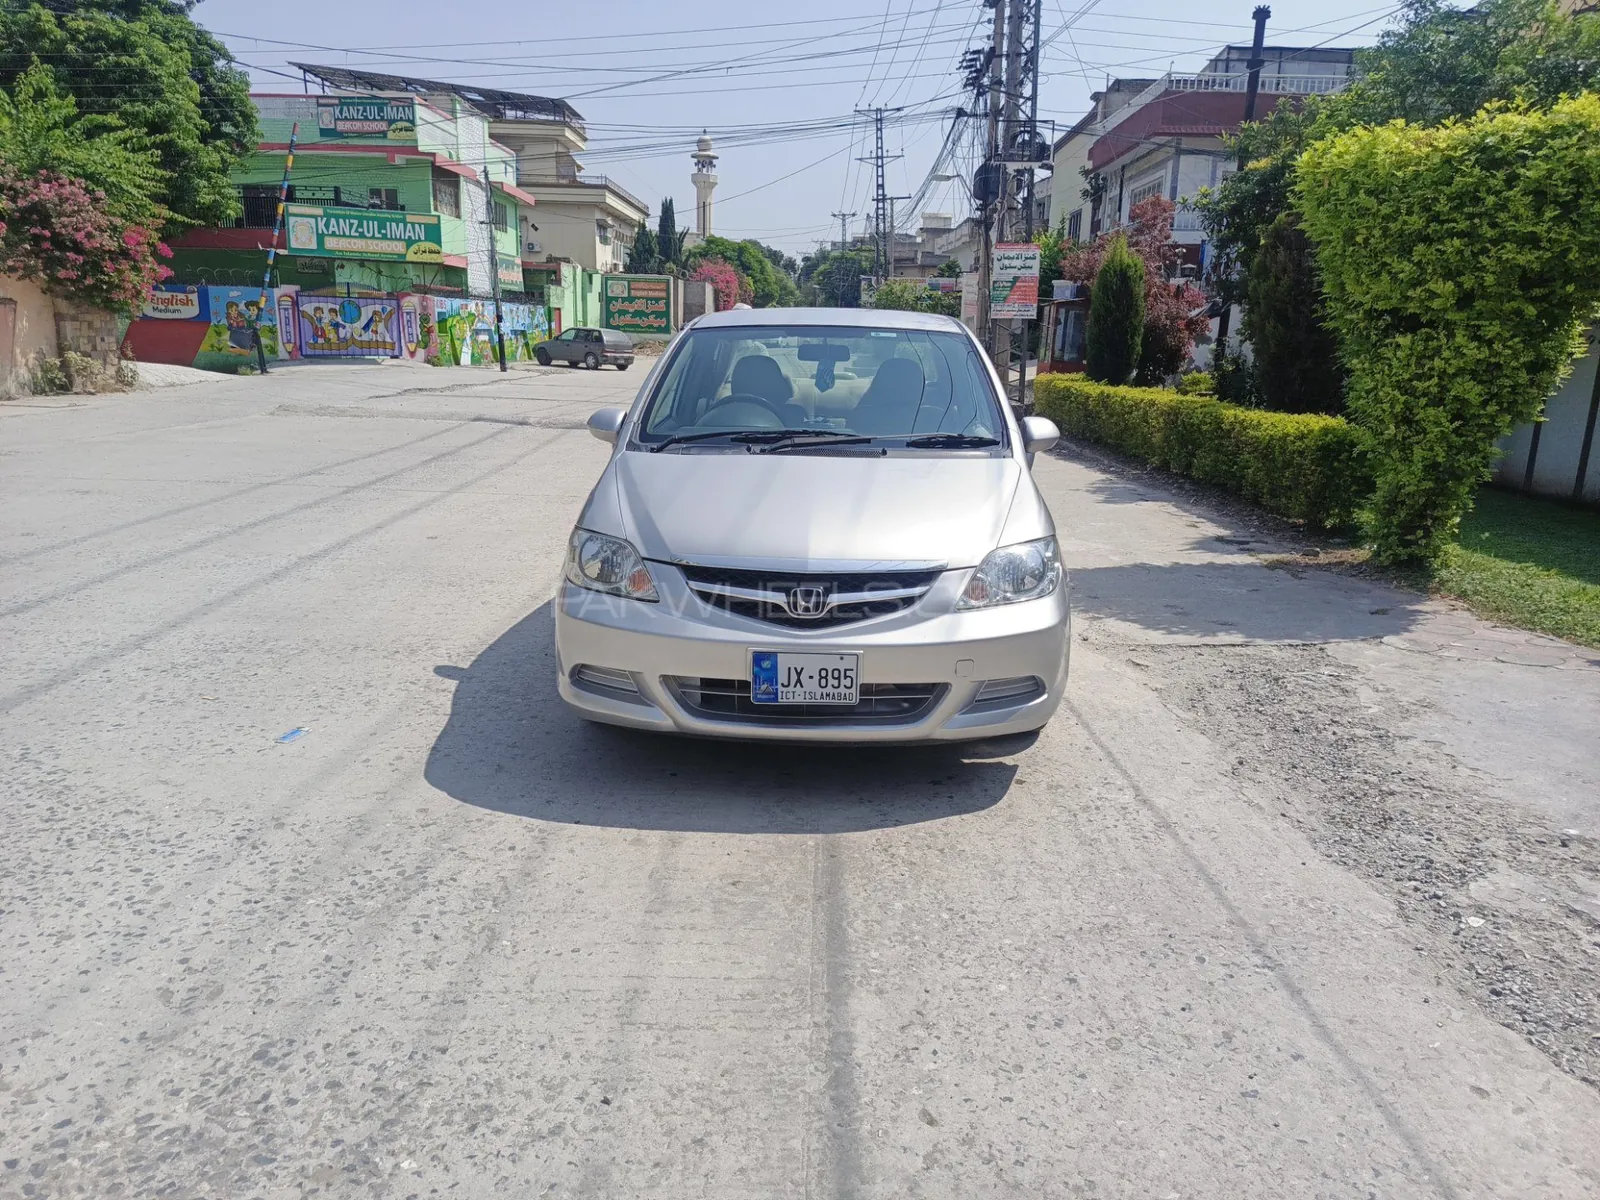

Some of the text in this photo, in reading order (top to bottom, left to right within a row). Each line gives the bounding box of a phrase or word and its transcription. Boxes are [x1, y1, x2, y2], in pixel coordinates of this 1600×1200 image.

[334, 105, 413, 120] KANZ-UL-IMAN
[337, 121, 387, 131] BEACON SCHOOL
[317, 216, 425, 241] KANZ-UL-IMAN
[326, 239, 405, 252] BEACON SCHOOL
[150, 294, 195, 307] English
[152, 306, 182, 314] Medium
[780, 666, 855, 690] JX-895
[780, 690, 855, 702] ICT-ISLAMABAD
